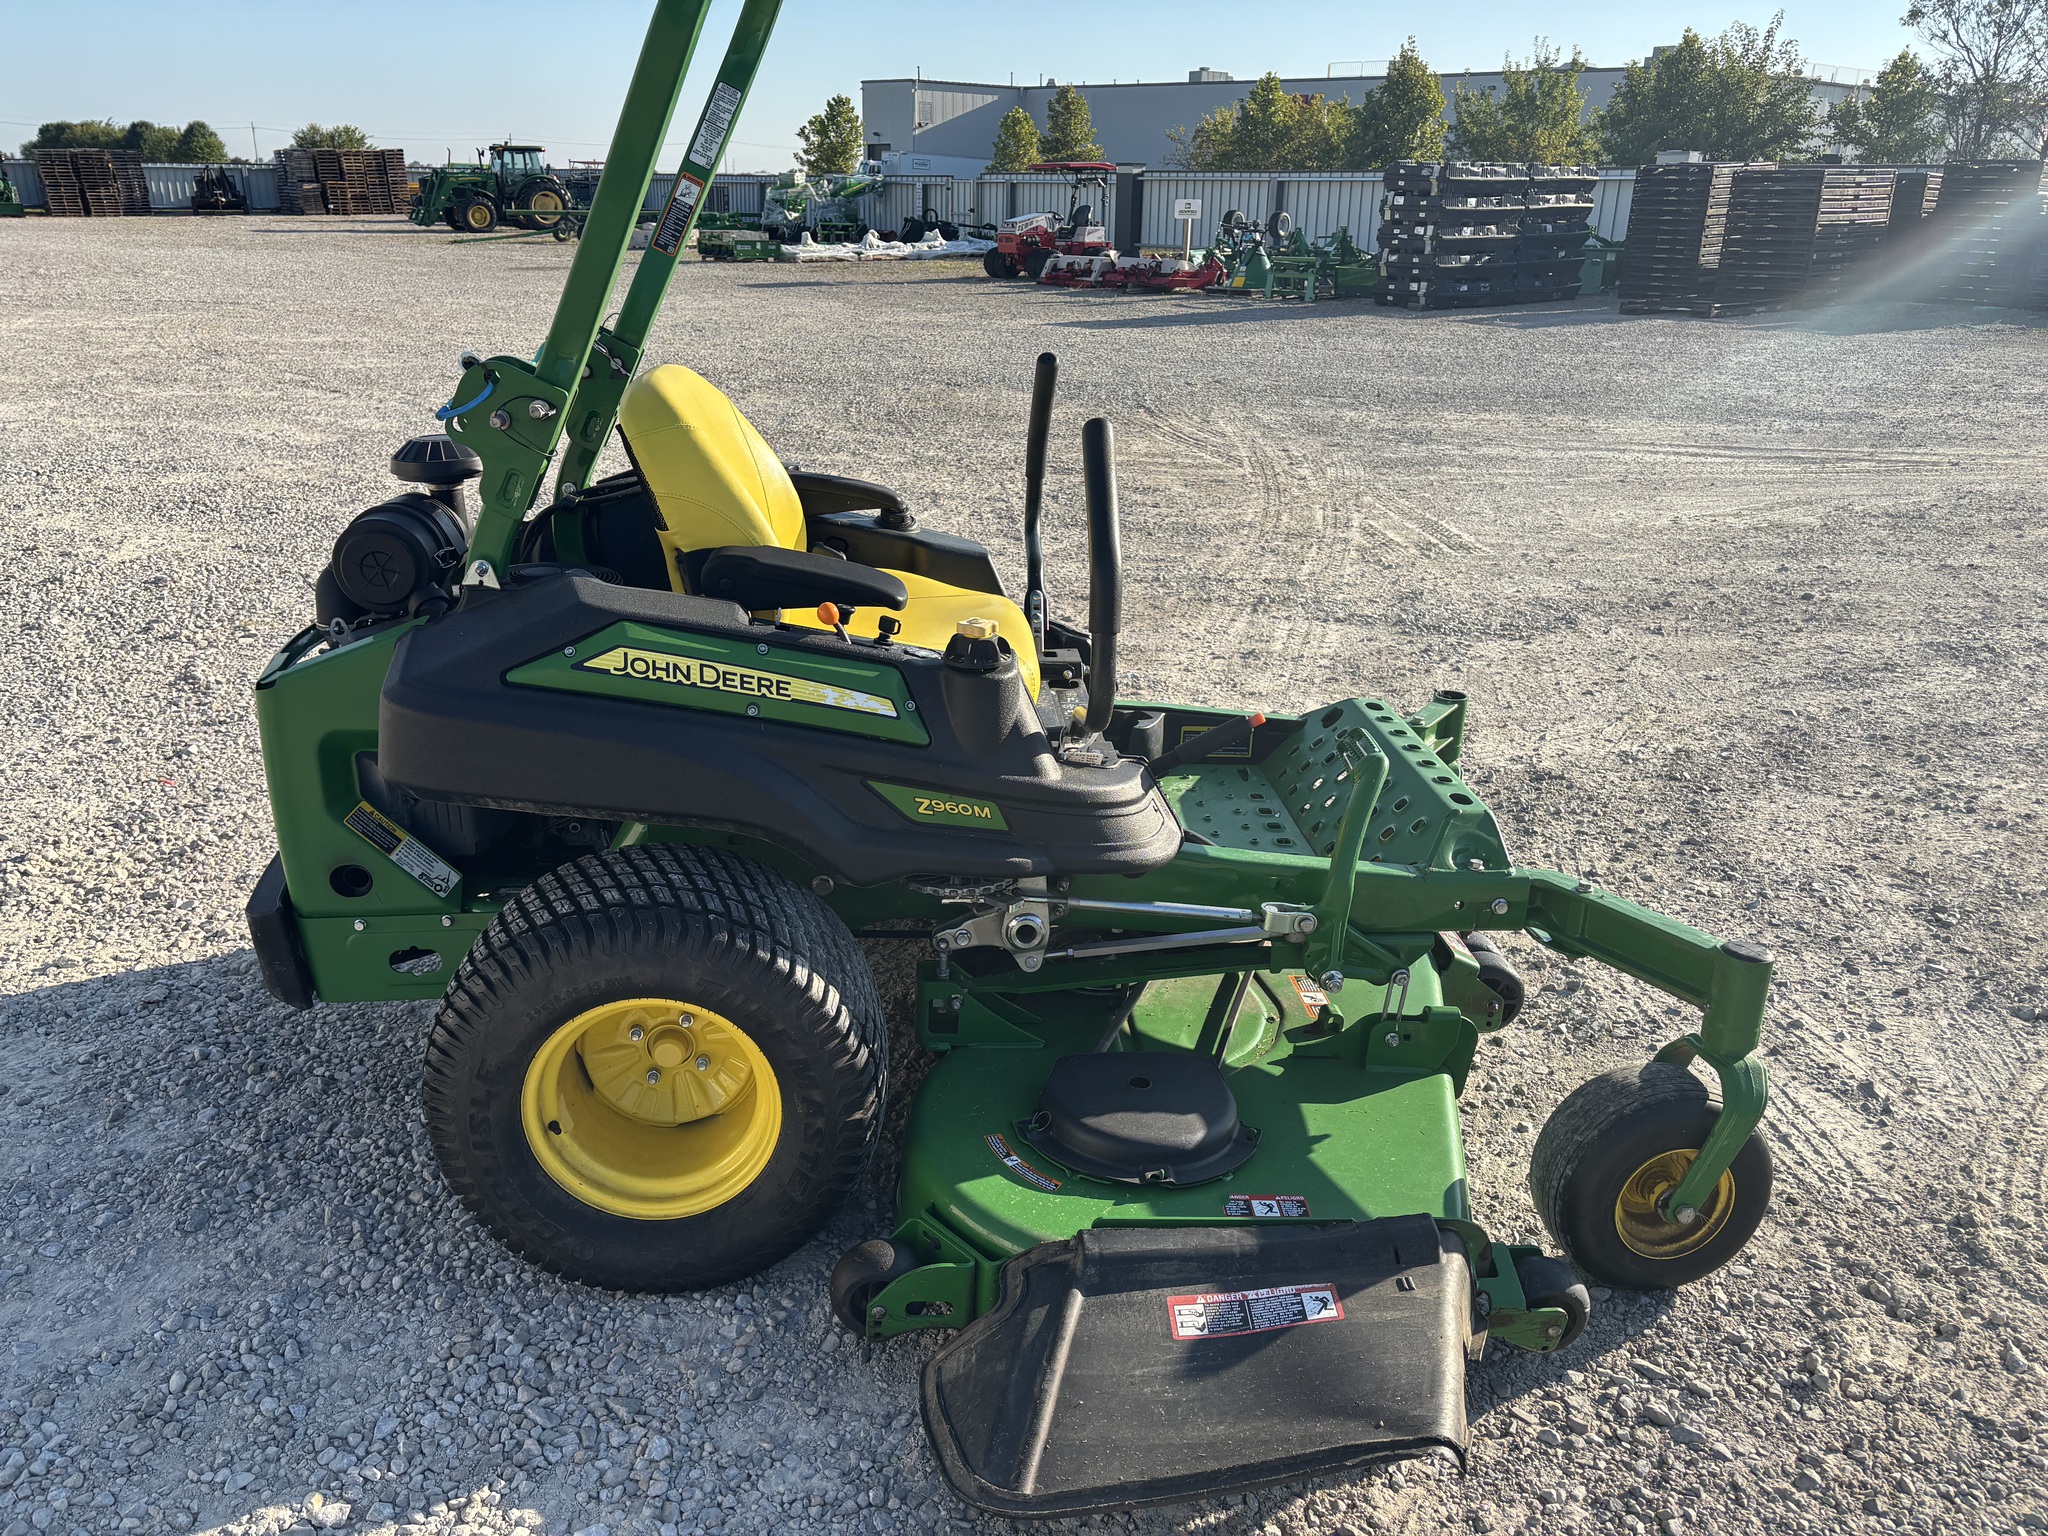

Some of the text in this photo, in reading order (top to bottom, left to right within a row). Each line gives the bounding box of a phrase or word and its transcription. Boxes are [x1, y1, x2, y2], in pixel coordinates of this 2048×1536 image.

[613, 652, 792, 698] JOHN DEERE
[914, 797, 992, 819] Z960M
[374, 813, 398, 833] CAUTION
[1207, 1293, 1242, 1302] DANGER
[1259, 1287, 1296, 1298] PELIGRO
